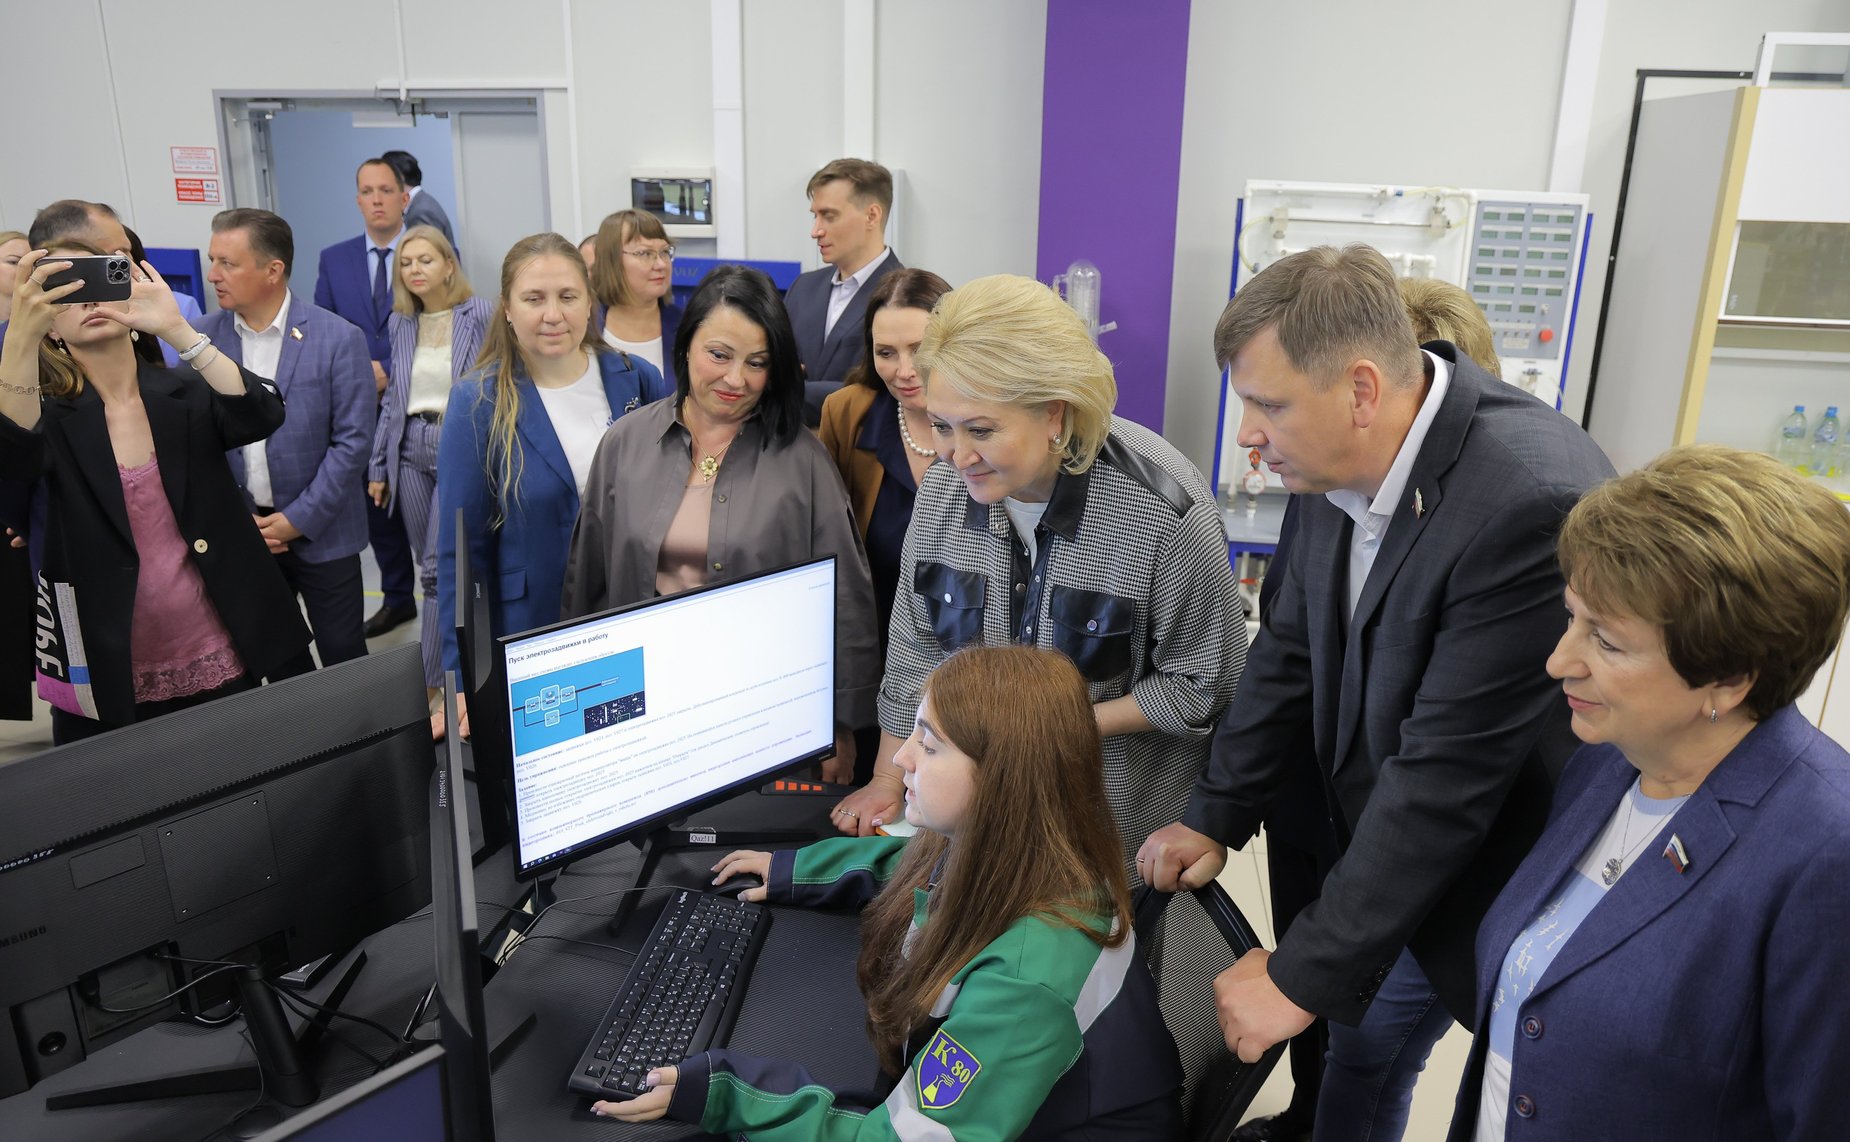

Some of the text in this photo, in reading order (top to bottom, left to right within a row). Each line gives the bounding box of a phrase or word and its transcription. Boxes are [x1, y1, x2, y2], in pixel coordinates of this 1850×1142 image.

[508, 654, 525, 665] Пуск
[526, 640, 582, 659] электрозадвижки
[588, 632, 609, 644] работу
[950, 1060, 971, 1084] 80
